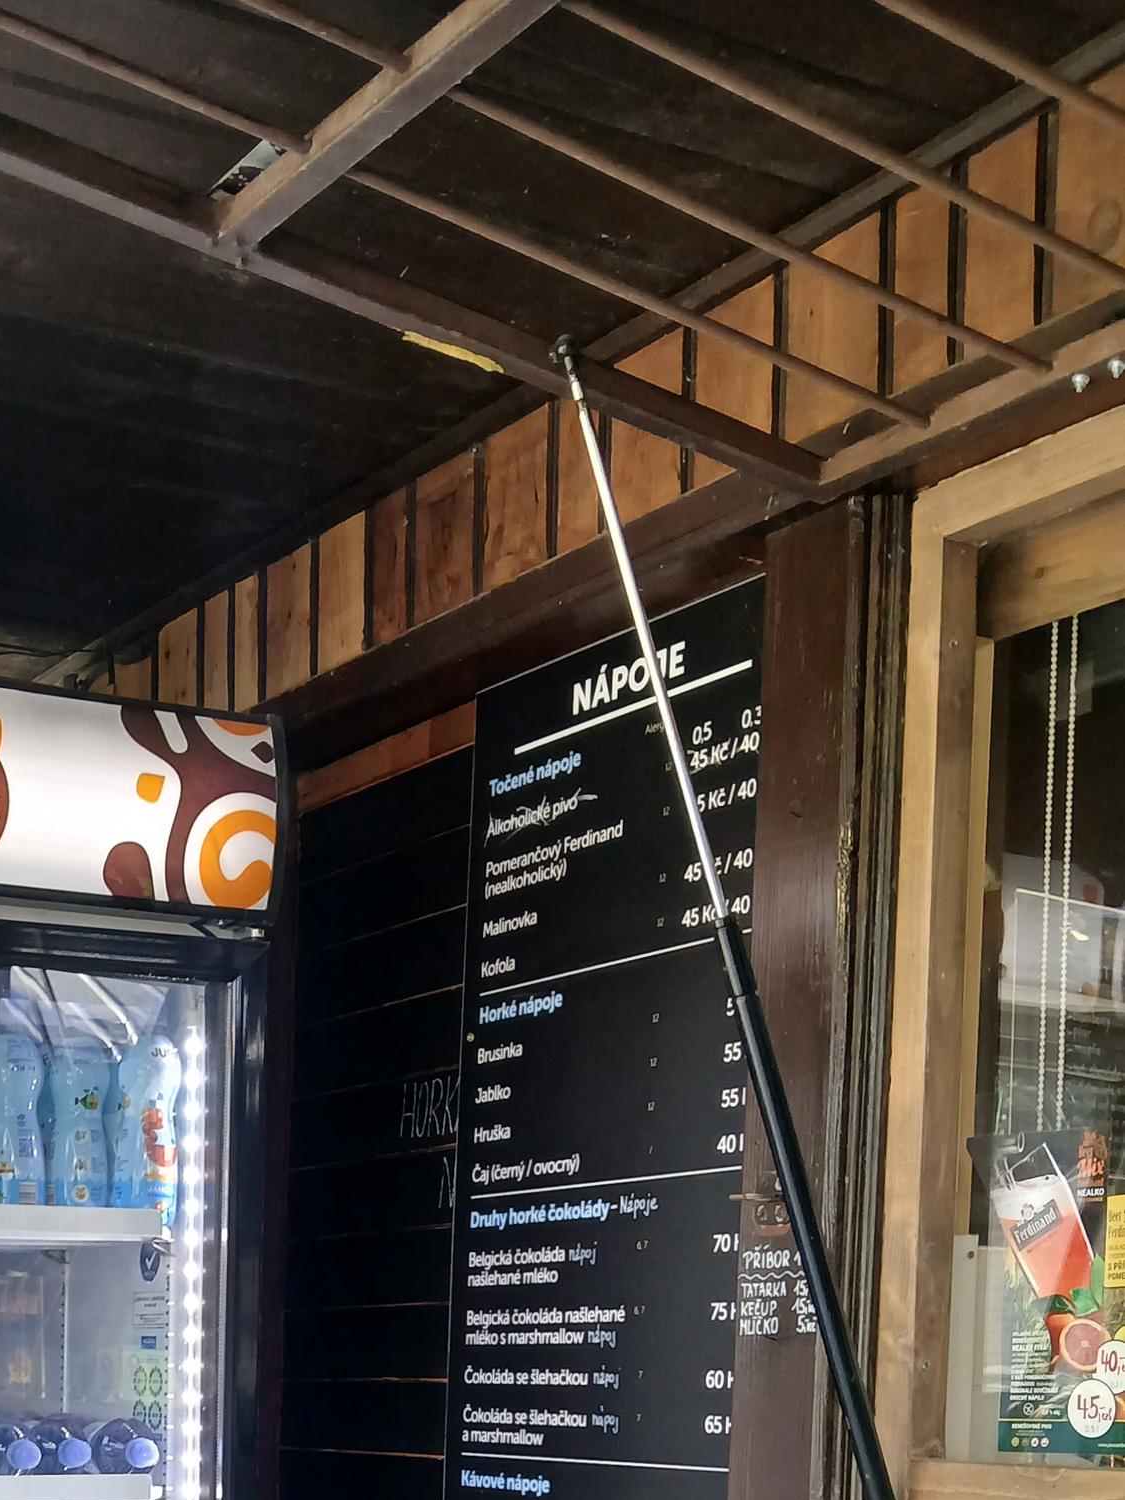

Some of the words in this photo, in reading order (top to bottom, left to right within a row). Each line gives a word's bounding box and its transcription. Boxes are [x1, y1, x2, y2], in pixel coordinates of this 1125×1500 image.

[572, 641, 686, 715] NÁPOJE
[487, 800, 551, 837] Alkoholické
[553, 796, 578, 820] pivo
[739, 732, 760, 753] 40
[489, 765, 534, 797] Točené
[536, 750, 582, 780] nápoje
[485, 841, 562, 878] Pomerančový
[564, 819, 624, 853] Ferdinand
[696, 794, 706, 812] 5
[708, 787, 726, 810] Kč
[737, 778, 757, 800] 40
[482, 908, 538, 938] Malinovka
[684, 862, 702, 882] 45
[733, 848, 753, 869] 40
[485, 858, 567, 900] (nealkoholický)
[480, 955, 516, 979] Kofola
[681, 907, 699, 928] 45
[731, 895, 751, 915] 40
[479, 998, 517, 1025] Horké
[518, 990, 564, 1018] nápoje
[477, 1041, 524, 1065] Brusinka
[474, 1084, 512, 1105] Jablko
[723, 1041, 742, 1063] 55
[400, 1076, 461, 1138] HORK
[473, 1124, 512, 1145] Hruška
[721, 1088, 739, 1108] 55
[471, 1162, 489, 1186] Čaj
[490, 1156, 526, 1183] (černý
[533, 1153, 581, 1179] ovocný)
[717, 1134, 737, 1153] 40
[1077, 1187, 1105, 1197] NEALKO
[470, 1204, 507, 1229] Druhy
[508, 1200, 546, 1225] horké
[547, 1198, 610, 1223] čokolády
[1014, 1207, 1056, 1243] Ferdinand
[468, 1250, 512, 1273] Belgická
[513, 1246, 565, 1266] čokoláda
[713, 1233, 731, 1253] 70
[742, 1244, 790, 1270] PŘÍBOR
[468, 1268, 521, 1288] našlehané
[522, 1267, 558, 1285] mléko
[741, 1281, 787, 1298] TATARKA
[467, 1310, 511, 1332] Belgická
[512, 1307, 563, 1327] čokoláda
[564, 1304, 626, 1324] našlehané
[710, 1302, 729, 1322] 75
[740, 1298, 778, 1317] KEČUP
[465, 1329, 498, 1347] mléko
[499, 1334, 506, 1346] s
[507, 1328, 584, 1347] marshmallow
[464, 1365, 514, 1386] Čokoláda
[516, 1371, 529, 1386] se
[531, 1365, 589, 1386] šlehačkou
[705, 1369, 725, 1390] 60
[462, 1403, 512, 1427] Čokoláda
[514, 1411, 528, 1427] se
[530, 1405, 587, 1428] šlehačkou
[704, 1414, 723, 1434] 65
[462, 1432, 469, 1443] a
[470, 1428, 544, 1447] marshmallow
[461, 1469, 505, 1491] Kávové
[506, 1473, 551, 1495] nápoje
